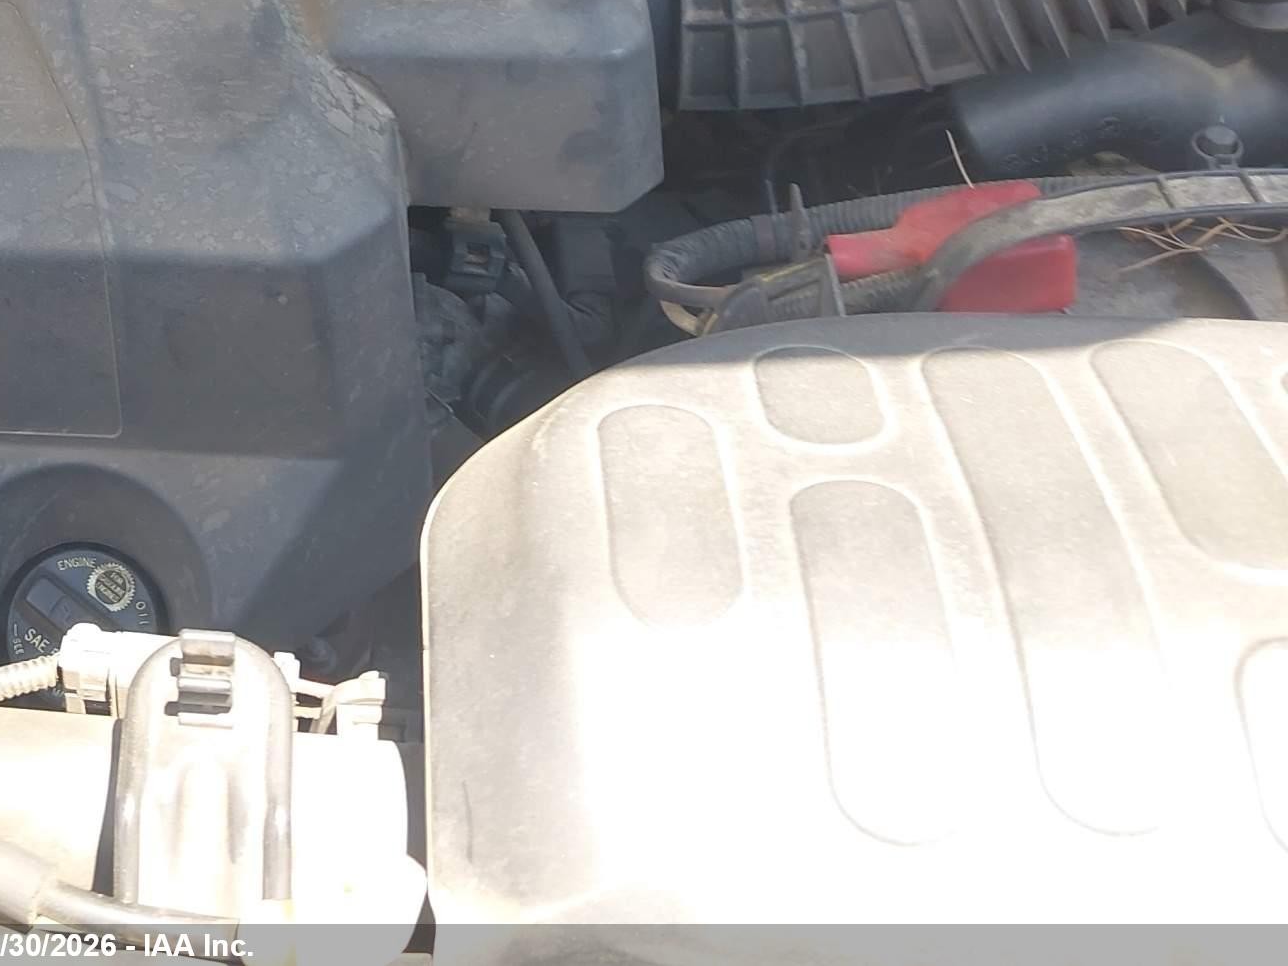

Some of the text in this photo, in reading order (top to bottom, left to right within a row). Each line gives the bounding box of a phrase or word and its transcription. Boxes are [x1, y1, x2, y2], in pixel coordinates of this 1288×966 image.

[57, 556, 150, 625] ENGINE OIL
[24, 628, 51, 653] SAE
